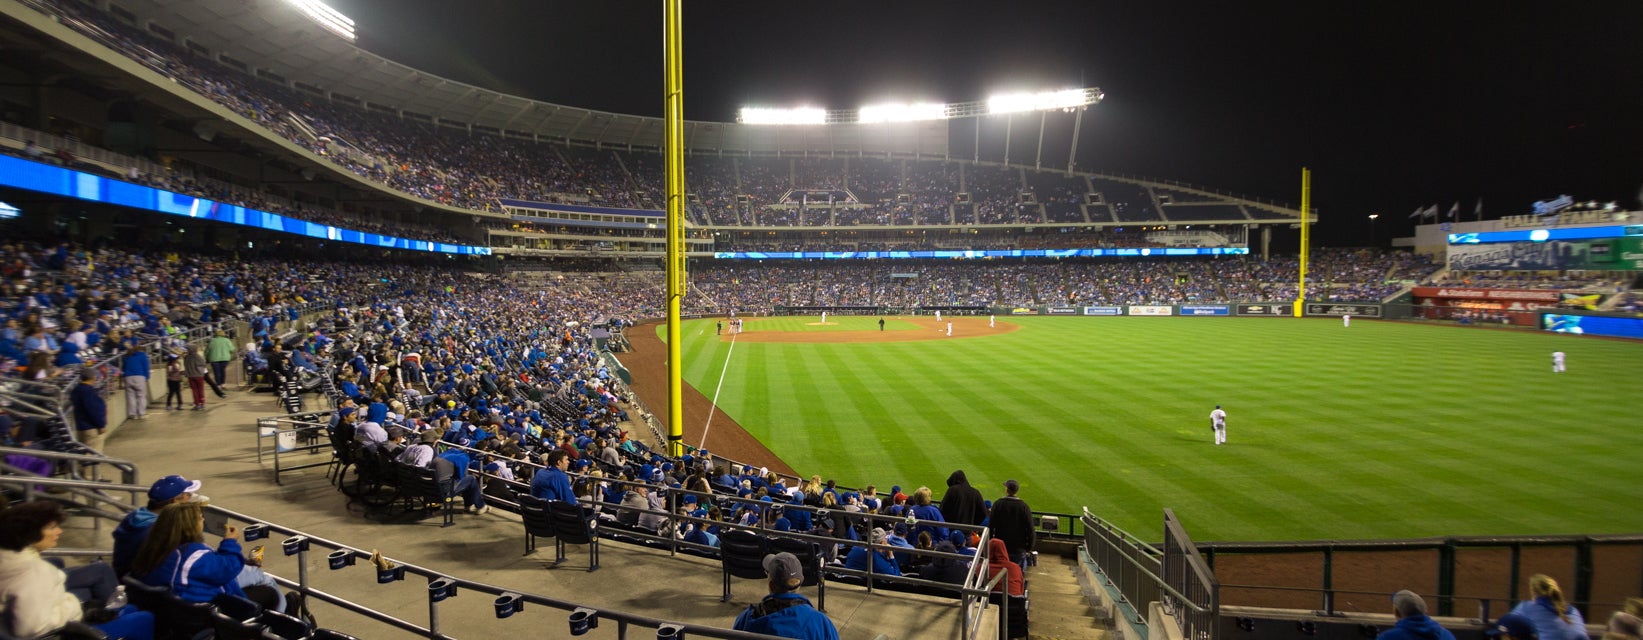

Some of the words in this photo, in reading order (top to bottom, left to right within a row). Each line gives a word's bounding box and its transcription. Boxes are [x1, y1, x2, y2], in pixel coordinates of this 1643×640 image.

[1502, 214, 1544, 227] HALL
[1559, 209, 1609, 225] FAME
[1450, 249, 1509, 269] Kansas
